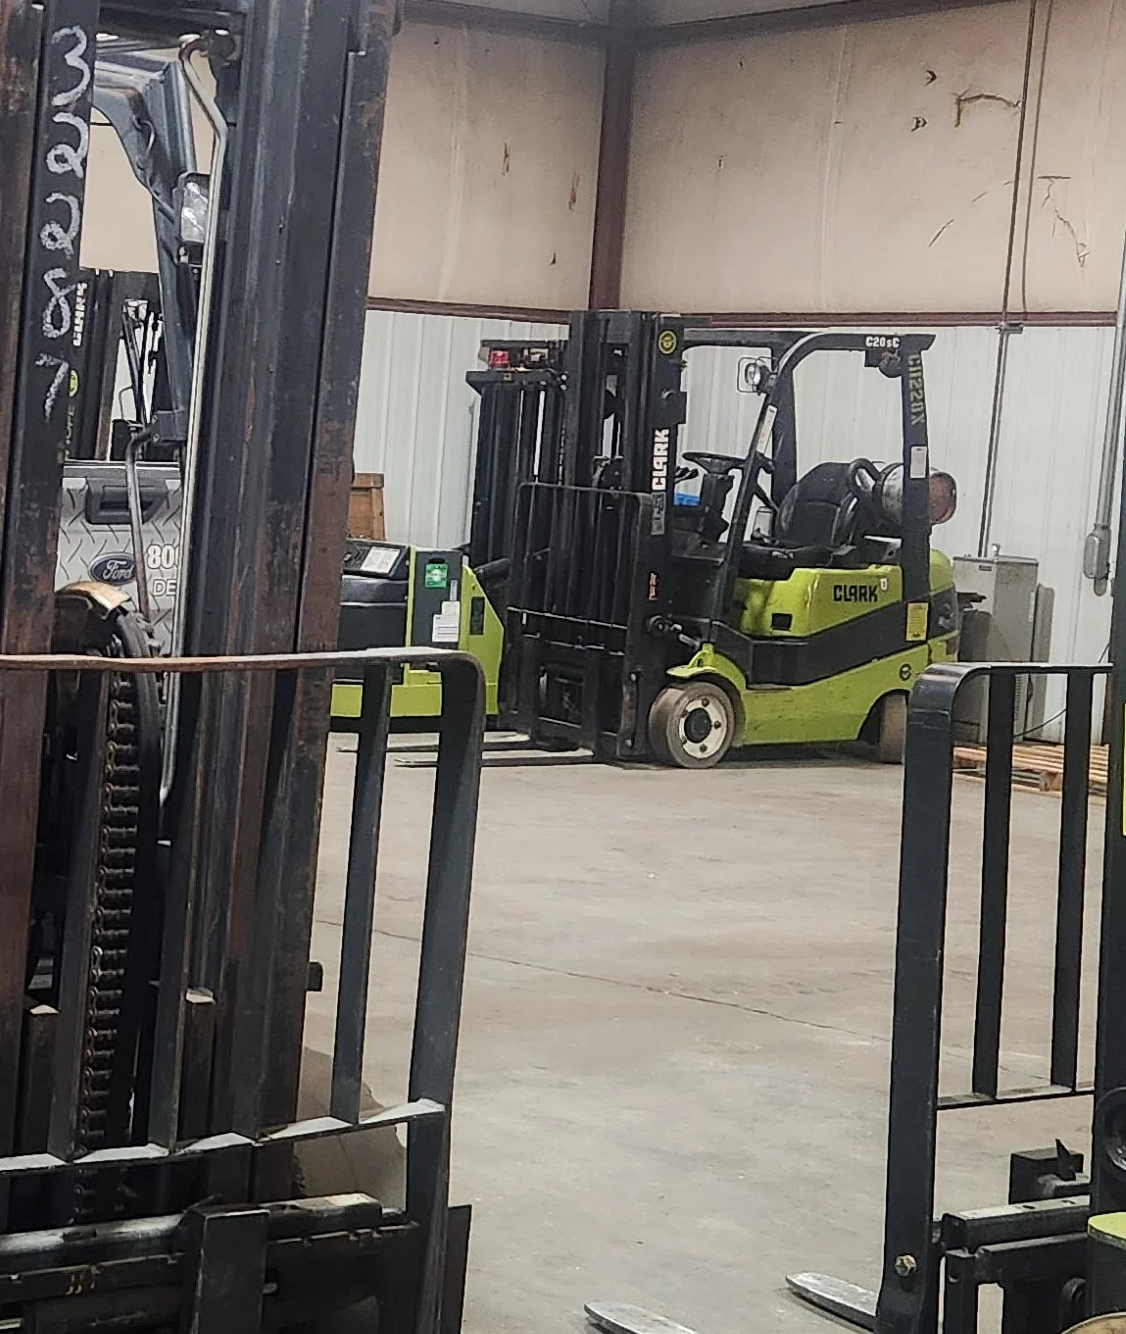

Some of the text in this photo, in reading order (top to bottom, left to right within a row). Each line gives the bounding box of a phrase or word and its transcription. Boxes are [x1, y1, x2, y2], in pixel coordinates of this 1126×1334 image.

[865, 336, 900, 348] C20sC
[652, 428, 670, 491] CLARK
[147, 544, 179, 569] 80
[102, 559, 134, 580] Ford
[833, 584, 878, 602] CLARK
